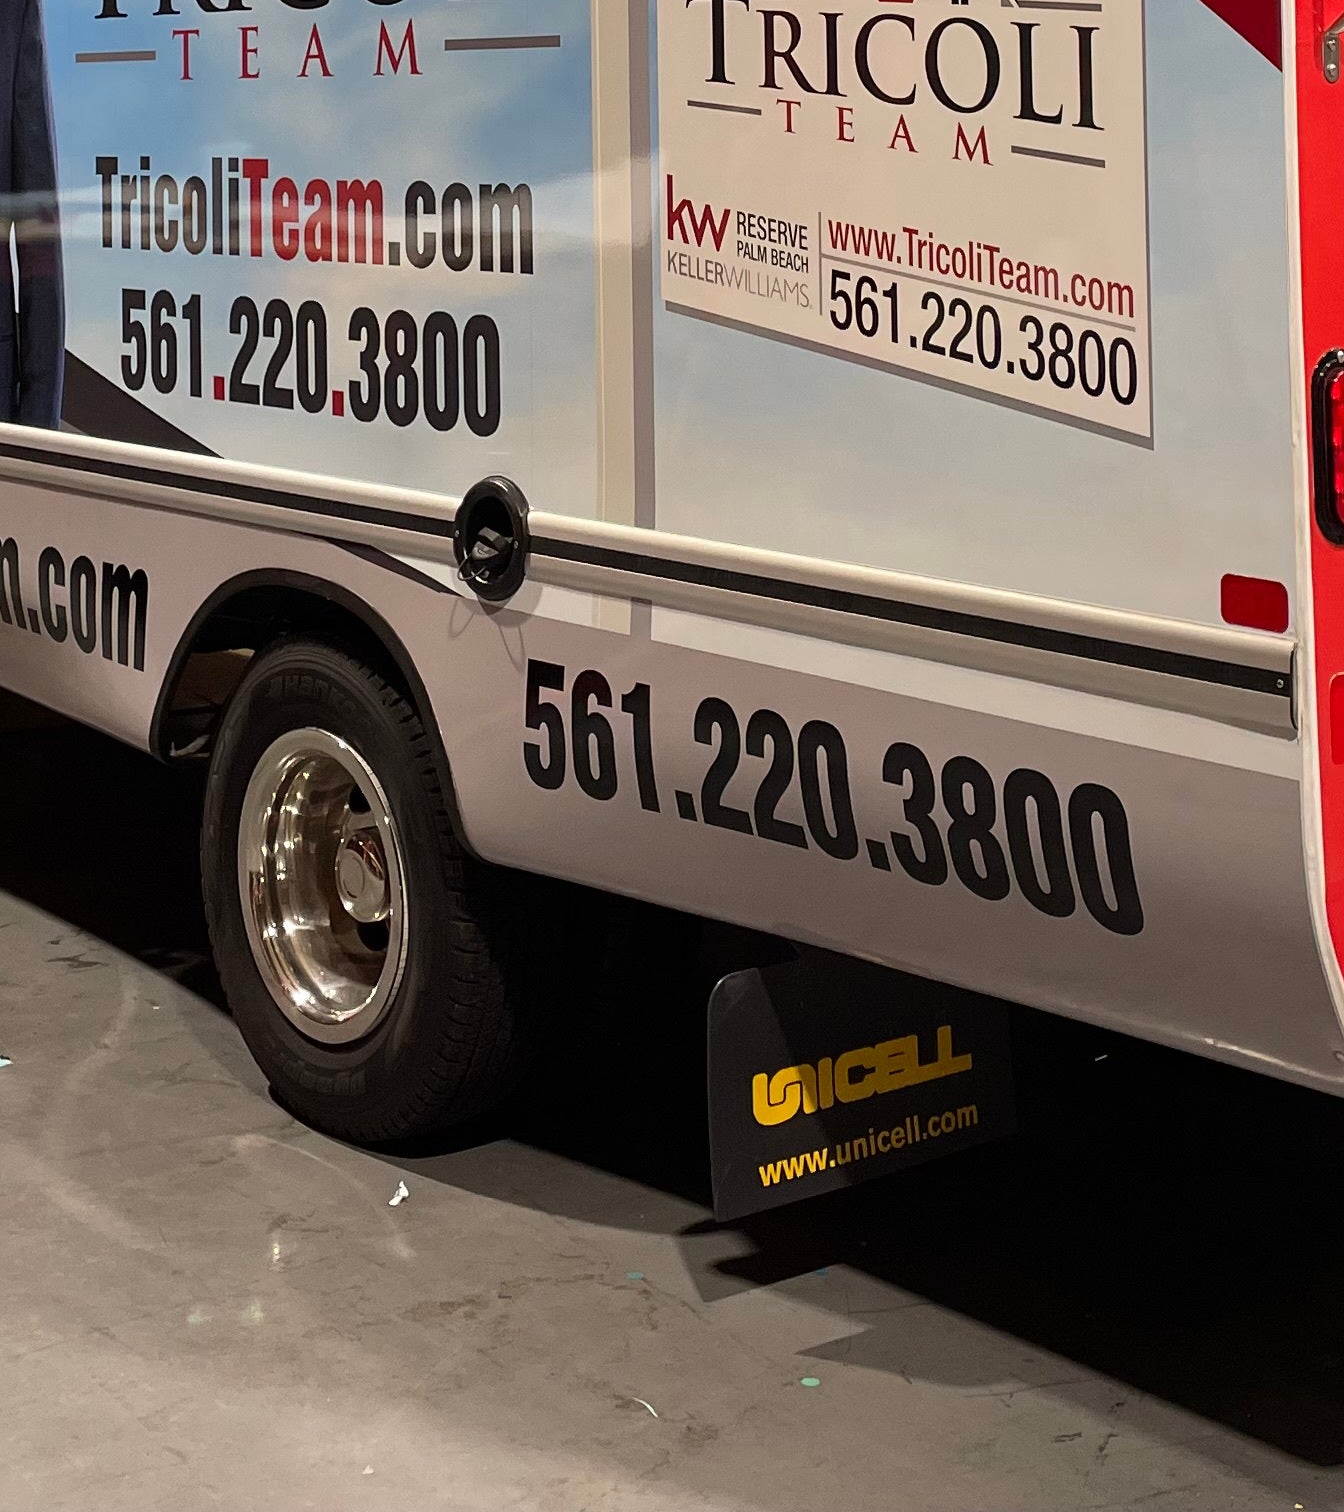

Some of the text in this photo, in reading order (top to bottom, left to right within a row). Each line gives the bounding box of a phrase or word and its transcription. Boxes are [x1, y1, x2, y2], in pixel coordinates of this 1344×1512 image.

[172, 18, 423, 81] TEAM
[775, 98, 994, 167] TEAM
[95, 155, 535, 275] TricoliTeam.com
[736, 210, 809, 251] RESERVE
[736, 239, 809, 274] PALM BEACH
[827, 219, 1135, 318] www.TricoliTeam.com
[120, 288, 501, 438] 561.220.3800
[830, 268, 1139, 406] 561.220.3800
[522, 657, 1144, 936] 561.220.3800
[752, 1024, 973, 1127] UNICELL
[758, 1104, 979, 1187] www.unicell.com
